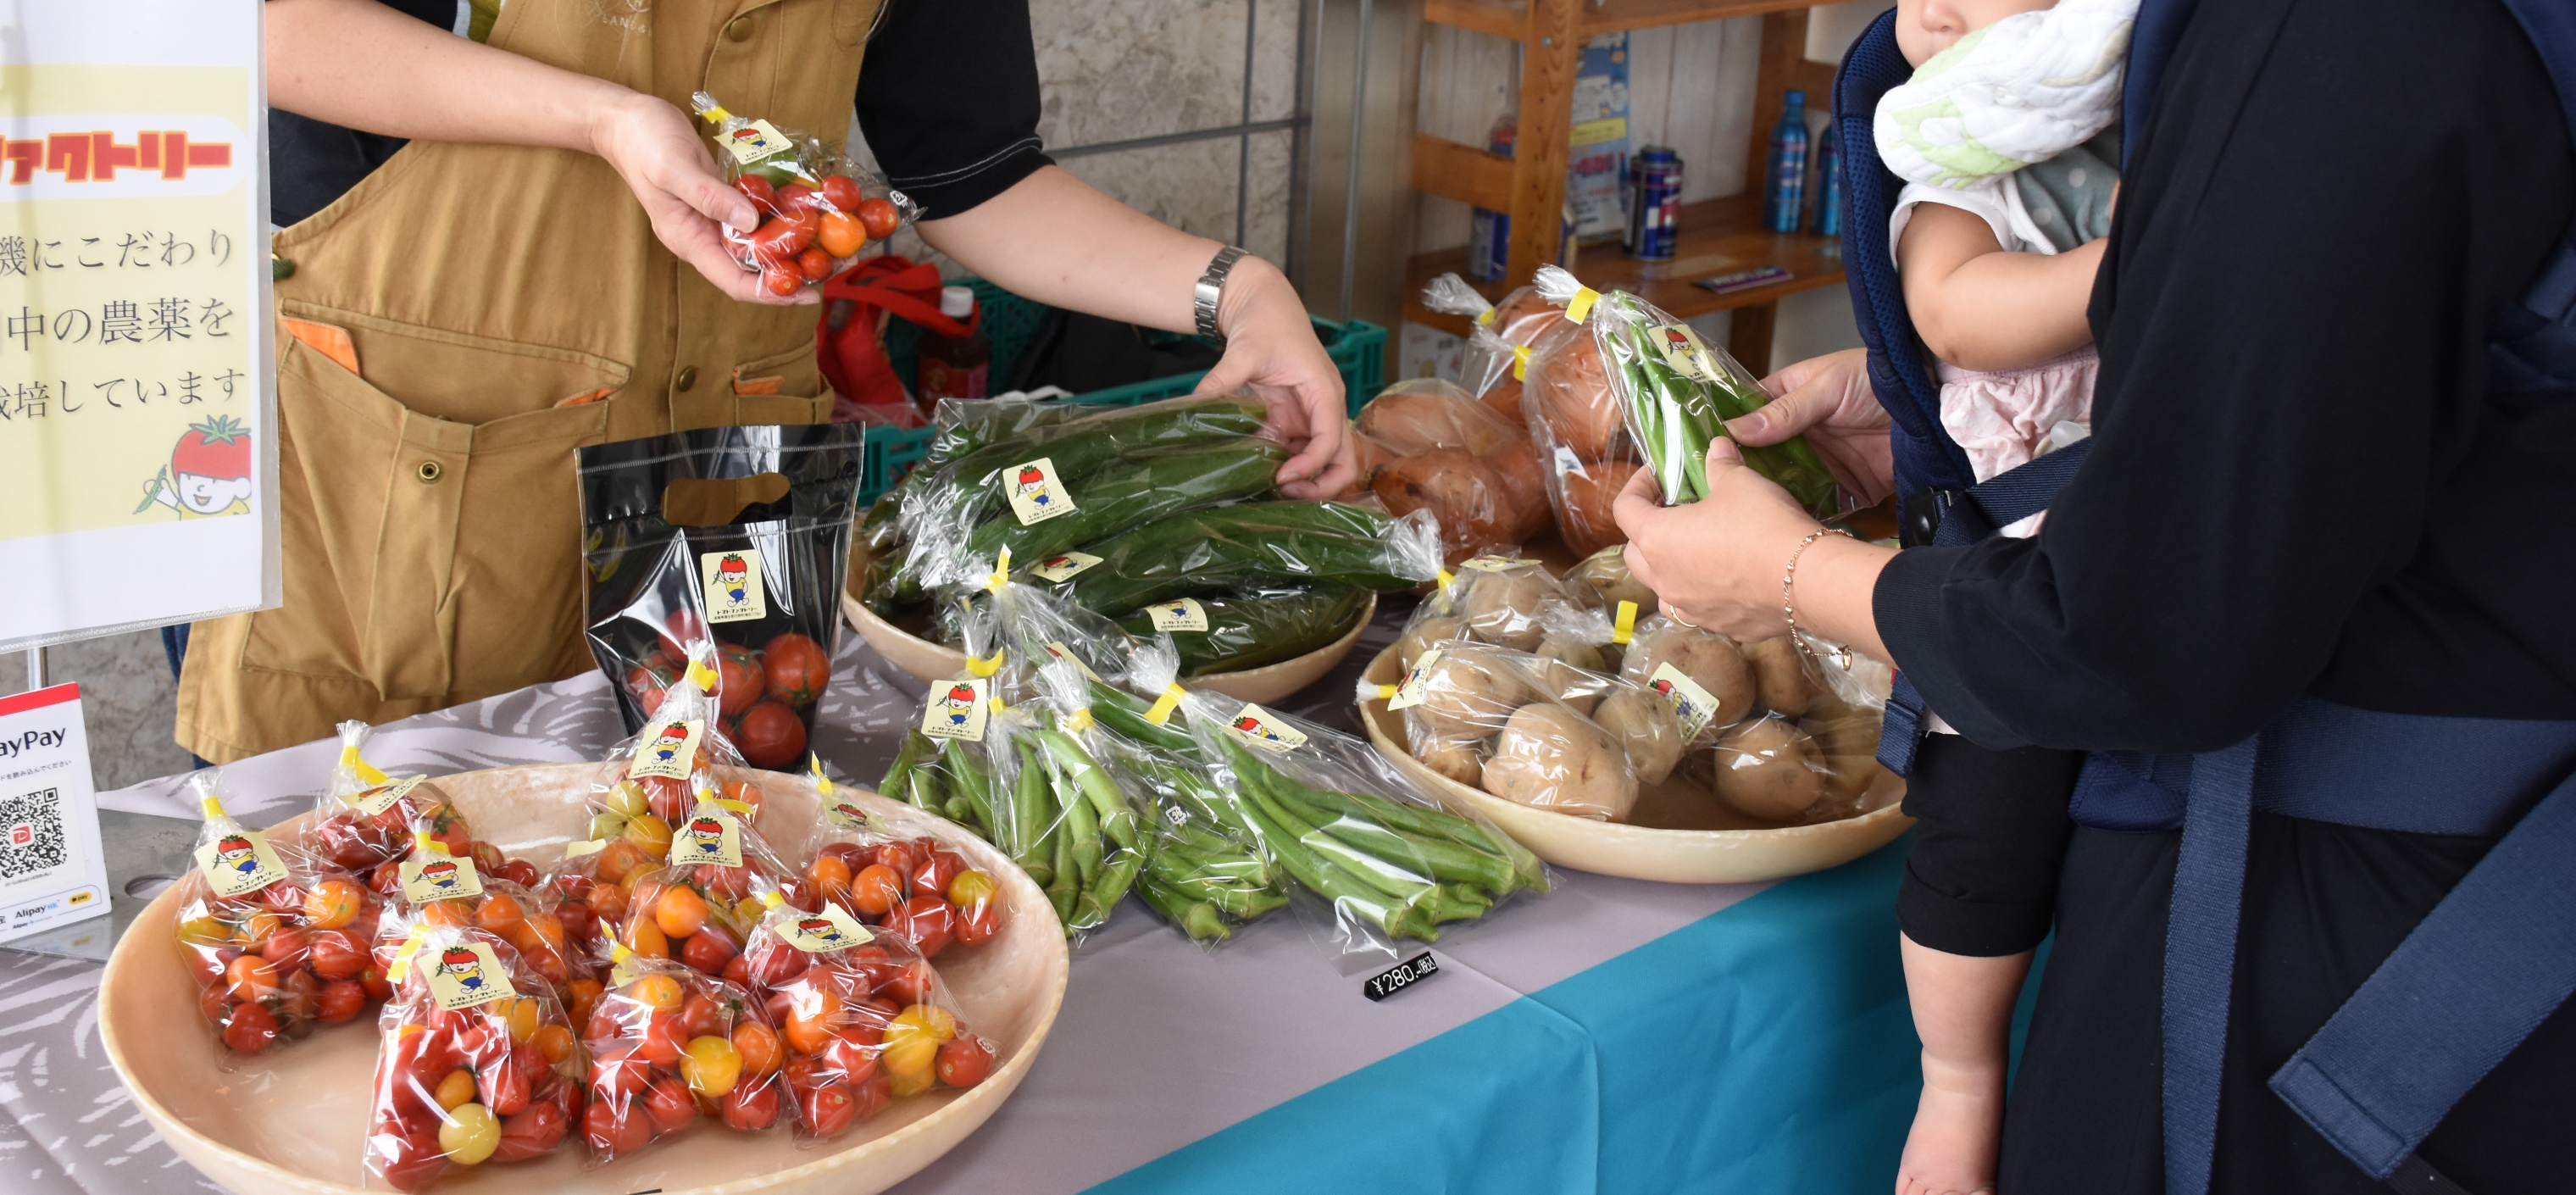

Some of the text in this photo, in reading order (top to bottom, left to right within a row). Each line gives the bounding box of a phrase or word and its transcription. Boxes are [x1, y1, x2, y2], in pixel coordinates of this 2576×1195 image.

[0, 130, 232, 186] ァクトリー
